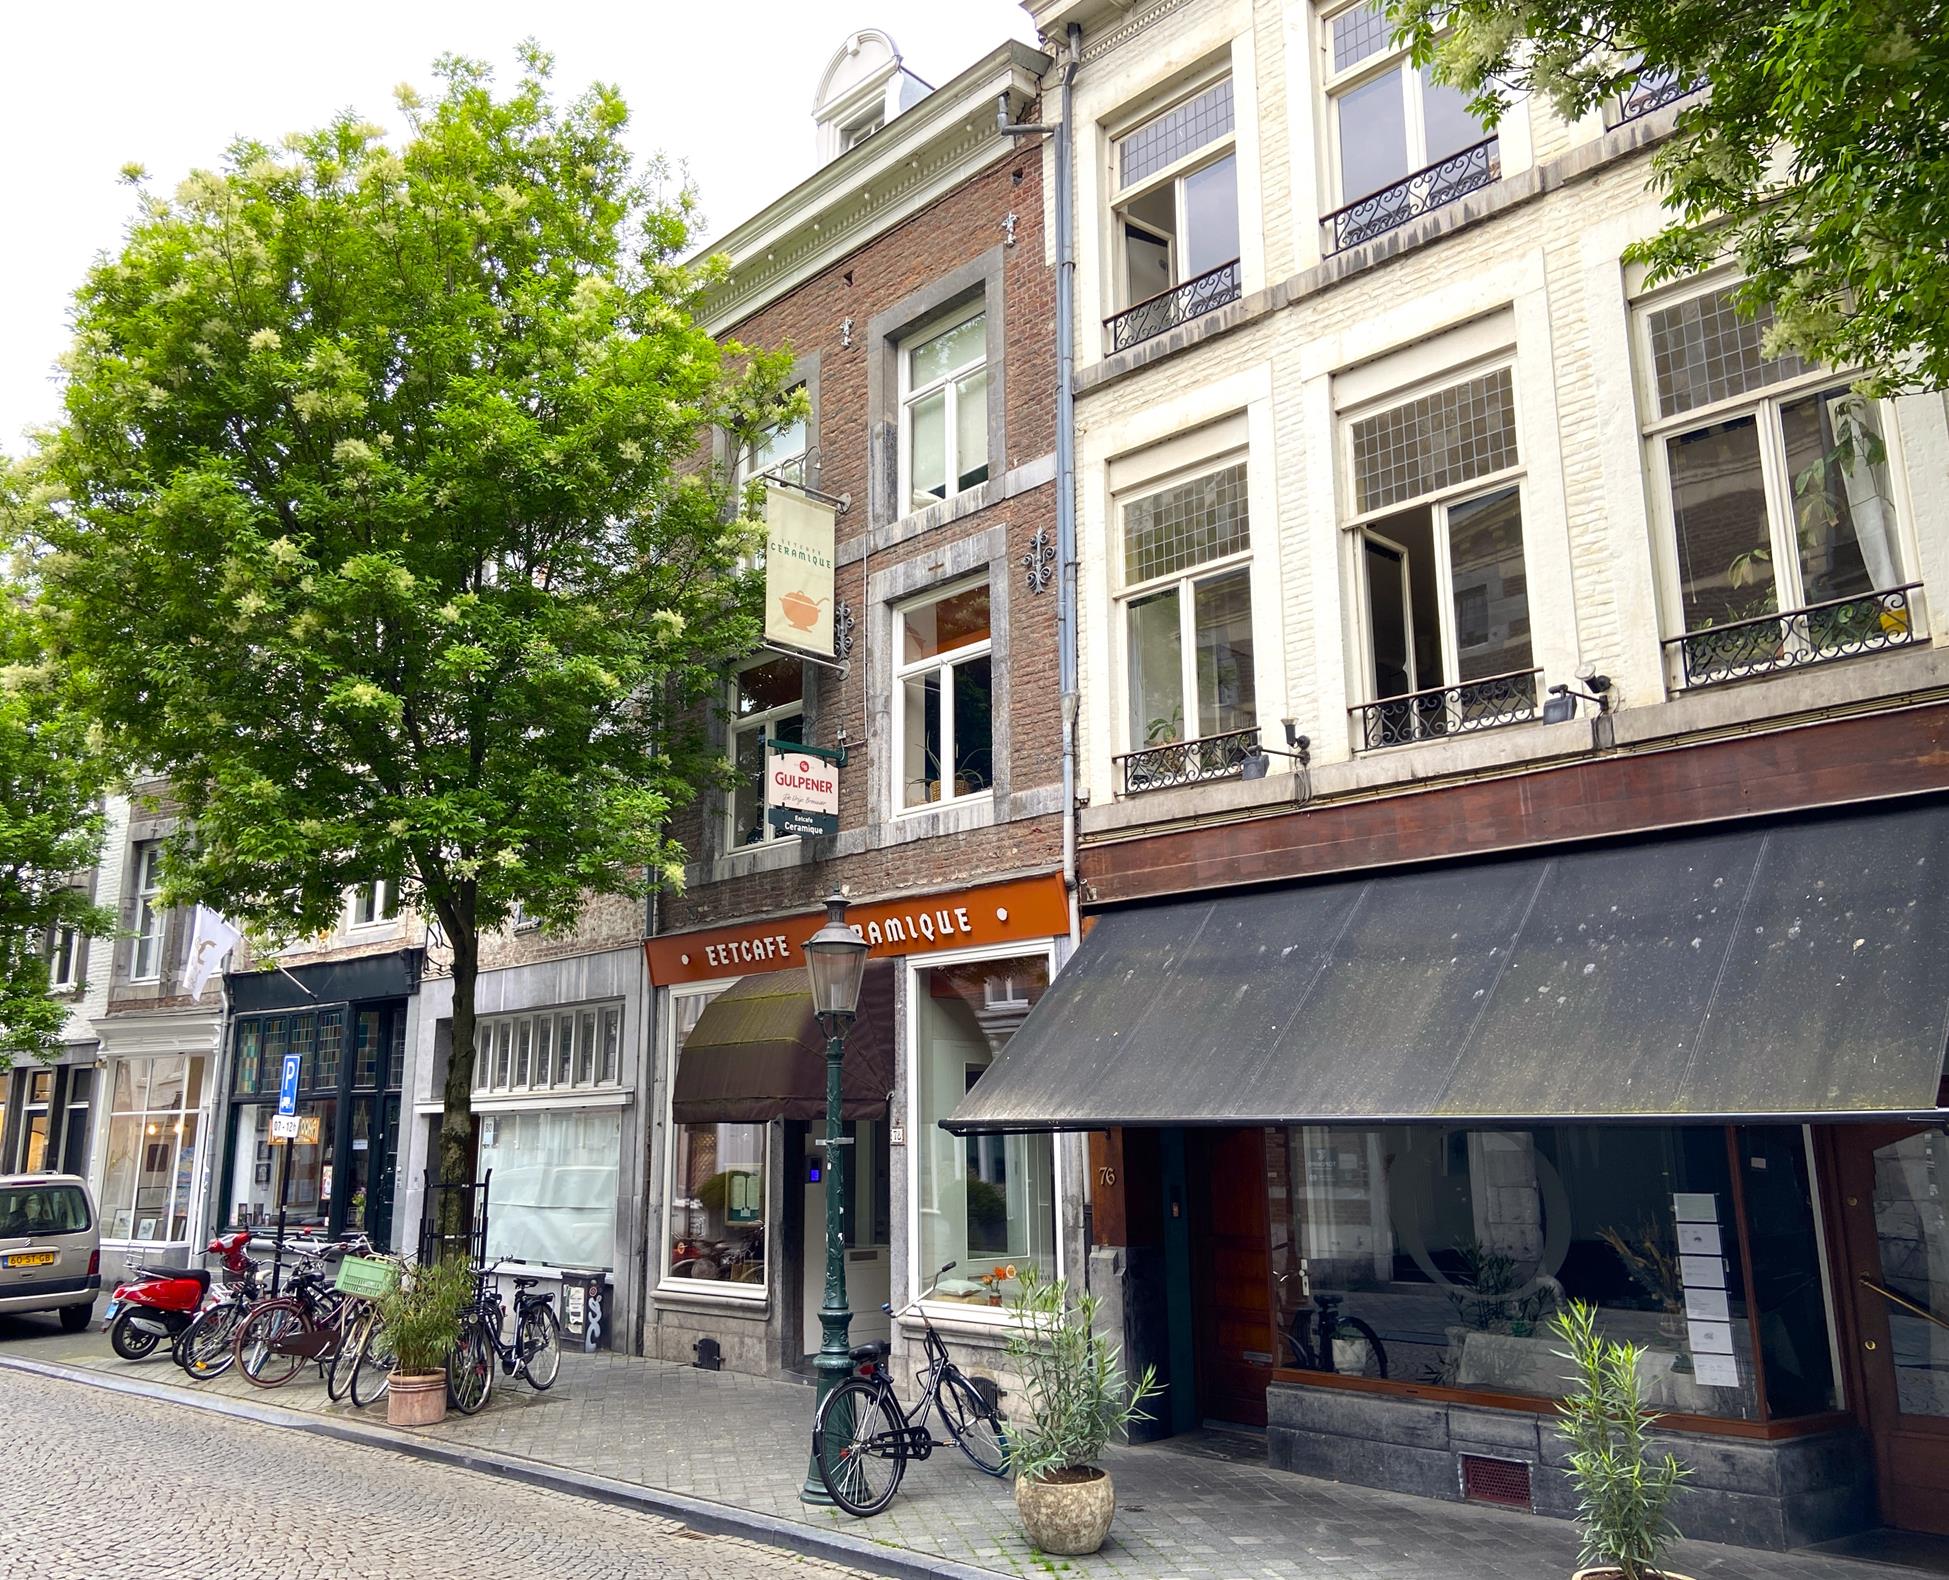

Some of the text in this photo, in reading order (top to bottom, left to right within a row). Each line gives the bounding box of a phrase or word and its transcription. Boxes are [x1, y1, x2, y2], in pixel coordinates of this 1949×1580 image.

[770, 542, 832, 569] CERAMIQUE
[775, 772, 833, 793] GULPENER
[784, 821, 823, 834] Ceramique
[704, 907, 972, 967] EETCAFE RAMIQUE
[284, 1061, 296, 1091] P
[1098, 1166, 1116, 1186] 76
